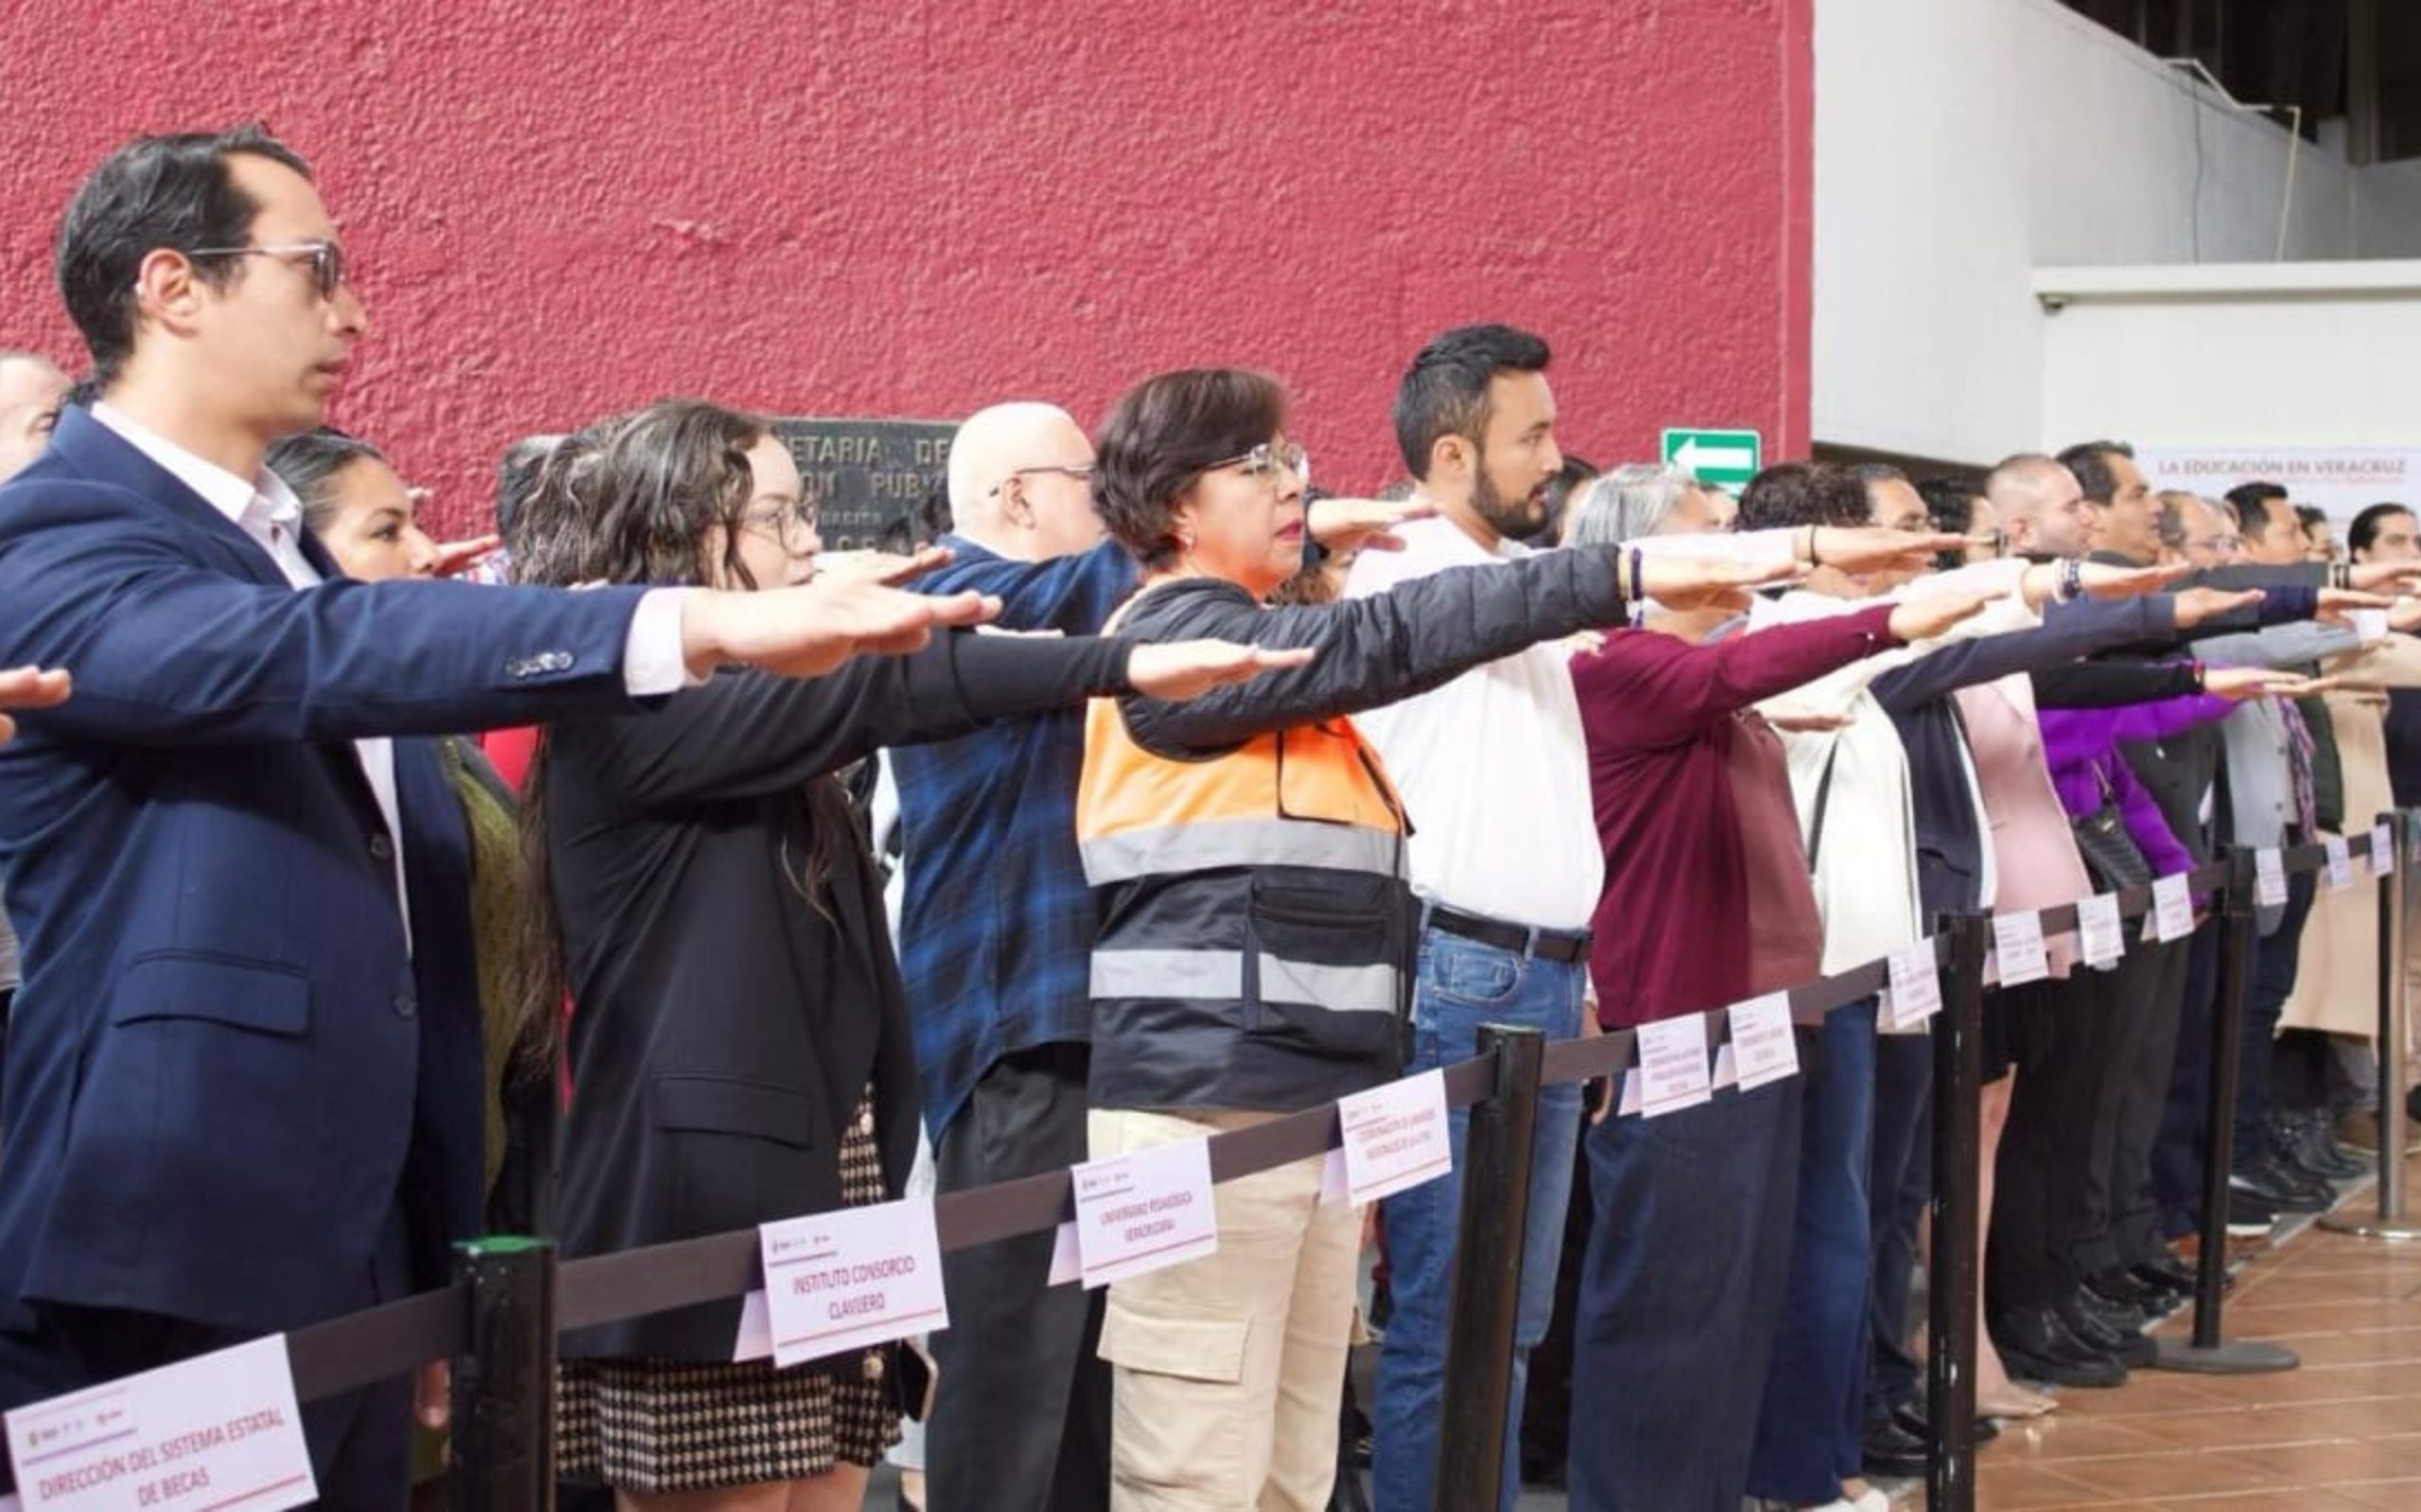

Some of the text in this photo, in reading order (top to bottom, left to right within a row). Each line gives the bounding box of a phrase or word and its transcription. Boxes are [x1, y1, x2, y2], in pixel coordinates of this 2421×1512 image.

[787, 436, 949, 464] ETARIA DE
[2158, 458, 2406, 474] LA EDUCACIÓN EN VERACRUZ
[793, 1256, 915, 1295] INSTITUTO CONSORCIO
[127, 1448, 158, 1472] DEL
[160, 1426, 225, 1462] SISTEMA
[227, 1407, 284, 1442] ESTATAL
[137, 1467, 210, 1507] DE BECAS
